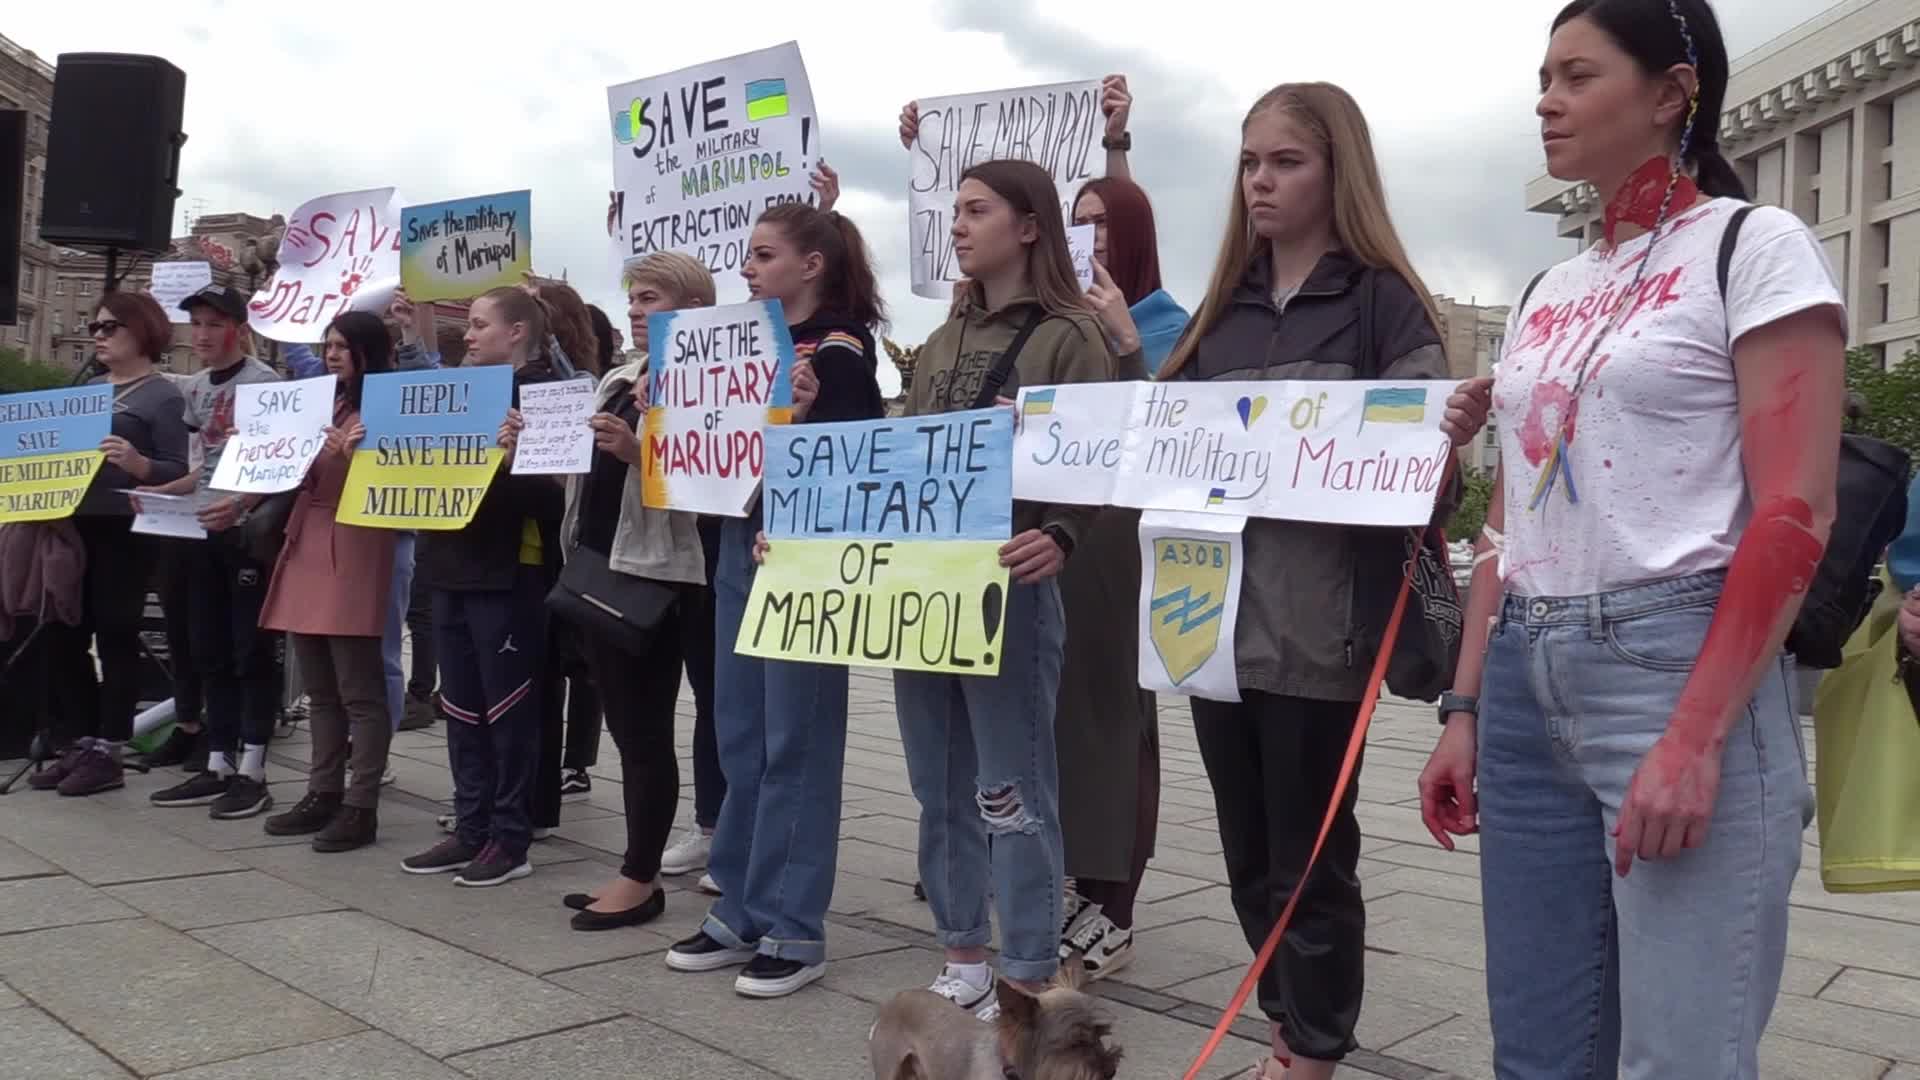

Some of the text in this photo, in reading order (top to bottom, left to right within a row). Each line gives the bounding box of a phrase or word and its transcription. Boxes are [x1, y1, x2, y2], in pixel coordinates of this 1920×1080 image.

[633, 76, 729, 159] SAVE
[655, 127, 760, 176] the MILITARY
[911, 103, 988, 193] SAVE
[645, 151, 790, 204] of MARIUPOL
[631, 200, 751, 255] EXTRACTION
[436, 245, 448, 274] of
[1517, 266, 1684, 346] MARIUPOL
[673, 320, 761, 365] SAVE THE
[60, 394, 108, 417] JOLIE
[250, 387, 304, 417] SAVE
[400, 383, 471, 415] HEPL!
[652, 358, 780, 408] MILITARY
[704, 410, 723, 431] OF
[1144, 385, 1188, 428] the
[17, 430, 60, 451] SAVE
[235, 435, 297, 463] heroes
[376, 434, 488, 466] SAVE THE
[648, 429, 763, 479] MARIUPO
[787, 418, 992, 479] SAVE THE
[1032, 420, 1451, 499] Save military Mariupol
[16, 457, 97, 483] MILITARY
[7, 488, 85, 512] MARIUPO
[362, 486, 483, 518] MILITARY
[769, 477, 976, 534] MILITARY
[839, 541, 894, 586] OF
[752, 582, 1003, 667] MARIUPOL!
